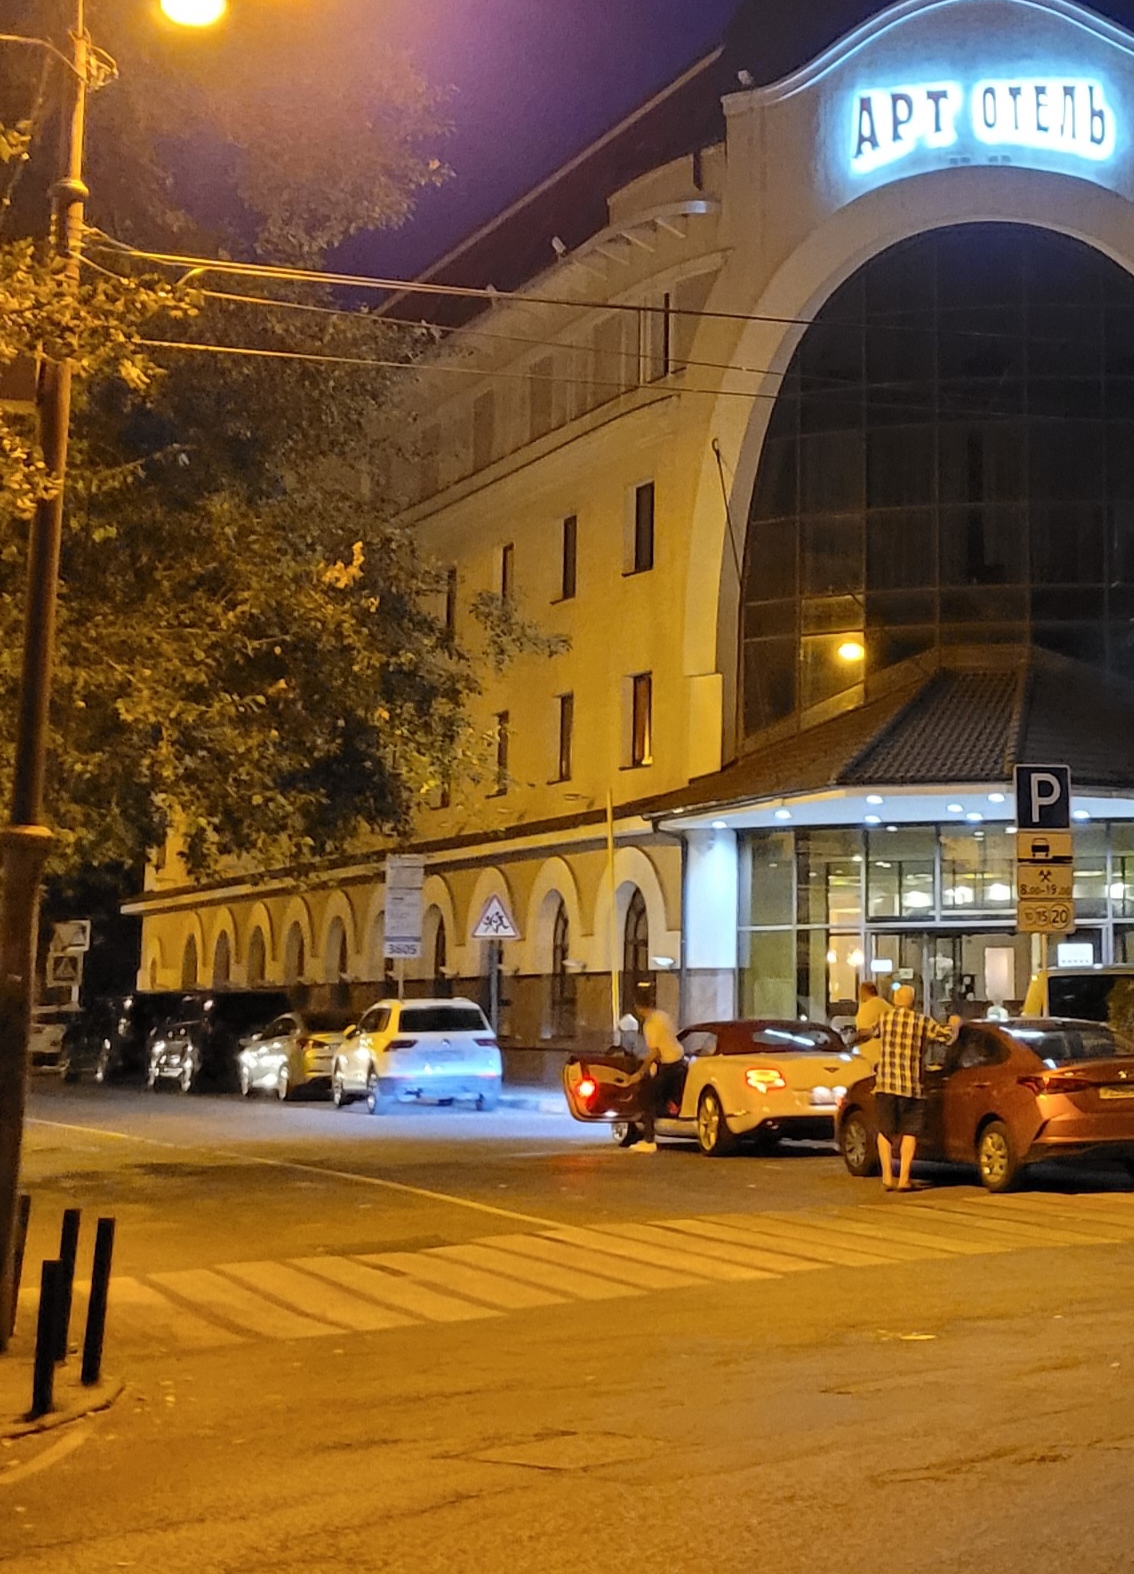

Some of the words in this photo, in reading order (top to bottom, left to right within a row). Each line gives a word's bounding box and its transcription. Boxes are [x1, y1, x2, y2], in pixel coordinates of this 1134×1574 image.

[854, 88, 949, 159] АРТ
[982, 84, 1106, 146] ОТЕЛЬ
[1030, 772, 1061, 824] P
[1051, 909, 1068, 924] 20
